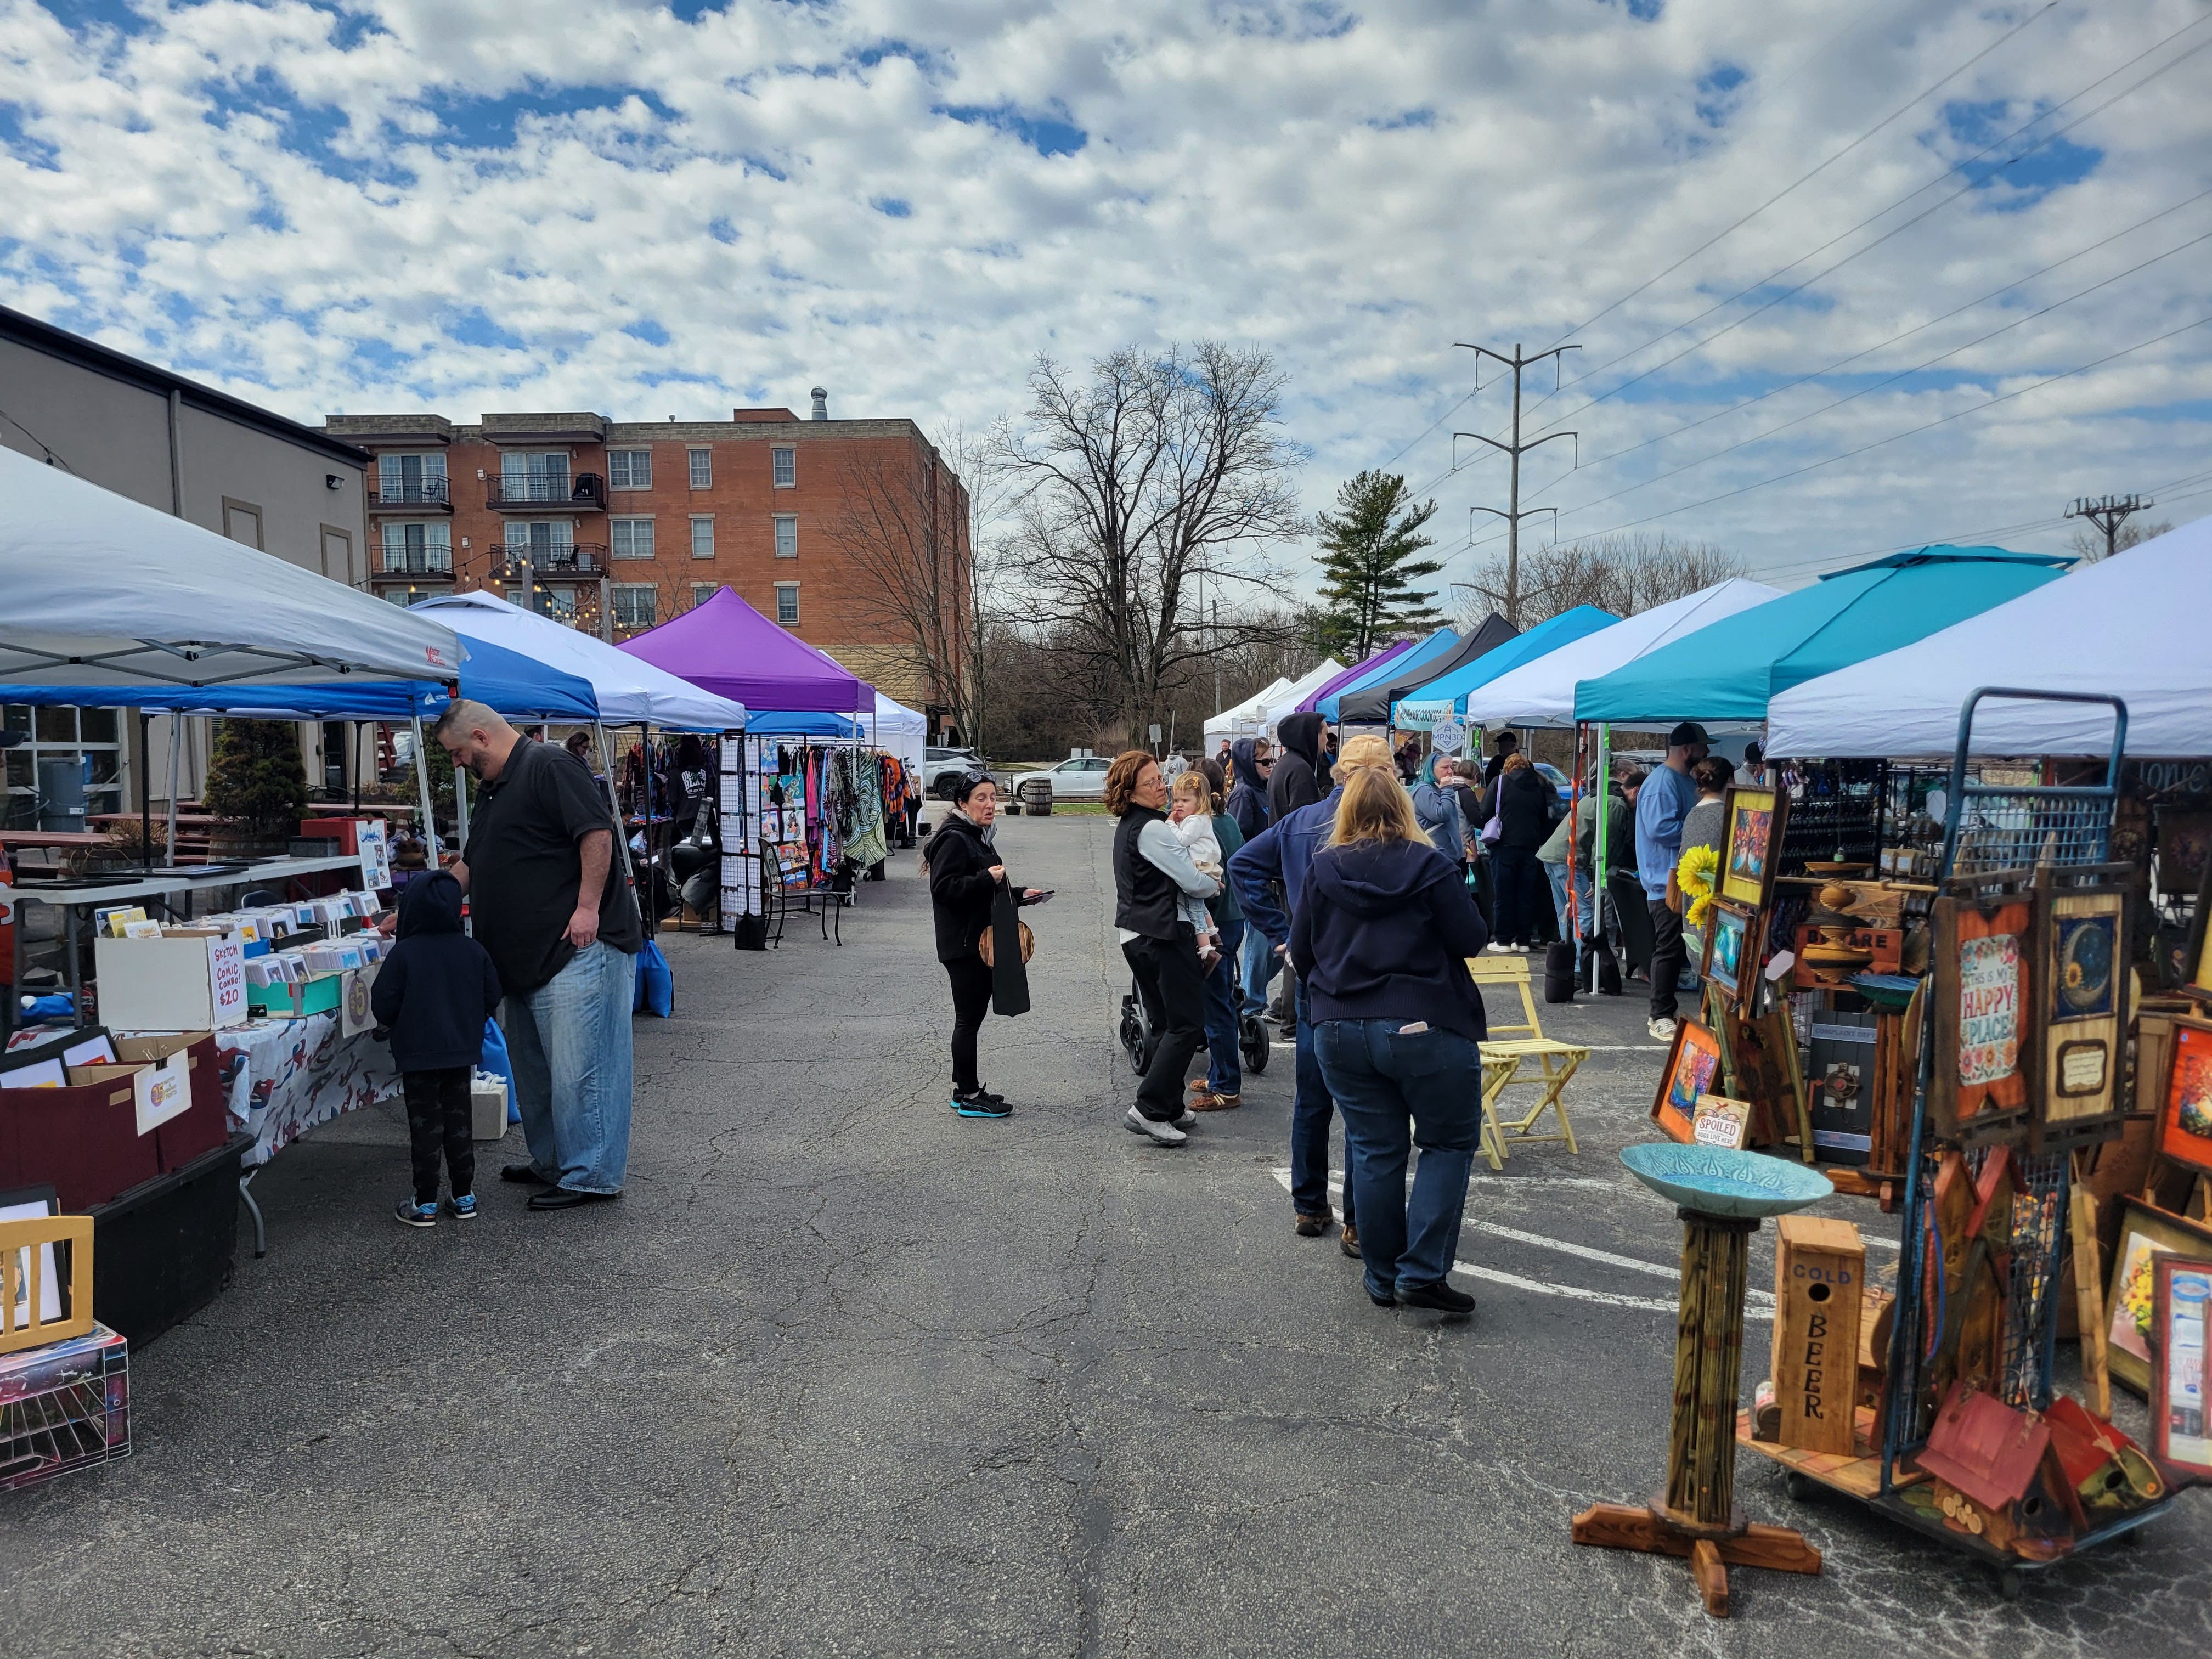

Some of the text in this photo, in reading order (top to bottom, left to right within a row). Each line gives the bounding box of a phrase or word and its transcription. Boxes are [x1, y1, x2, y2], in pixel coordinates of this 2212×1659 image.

[1807, 929, 1887, 948] BARE
[215, 944, 238, 962] SKETCH
[217, 963, 239, 981] COMIC
[1970, 968, 2007, 985] THIS IS MY
[219, 973, 241, 990] COMBO!
[219, 989, 239, 1006] $20
[349, 983, 365, 1017] $5
[1962, 983, 2015, 1019] HAPPY
[1815, 1028, 1854, 1036] COMPLAINT
[1968, 1014, 2013, 1045] PLACE
[1699, 1118, 1736, 1136] SPOILED
[1697, 1131, 1709, 1139] DOGS
[1710, 1133, 1721, 1142] LIVE
[1793, 1264, 1852, 1285] COLD
[1804, 1314, 1827, 1420] BEER
